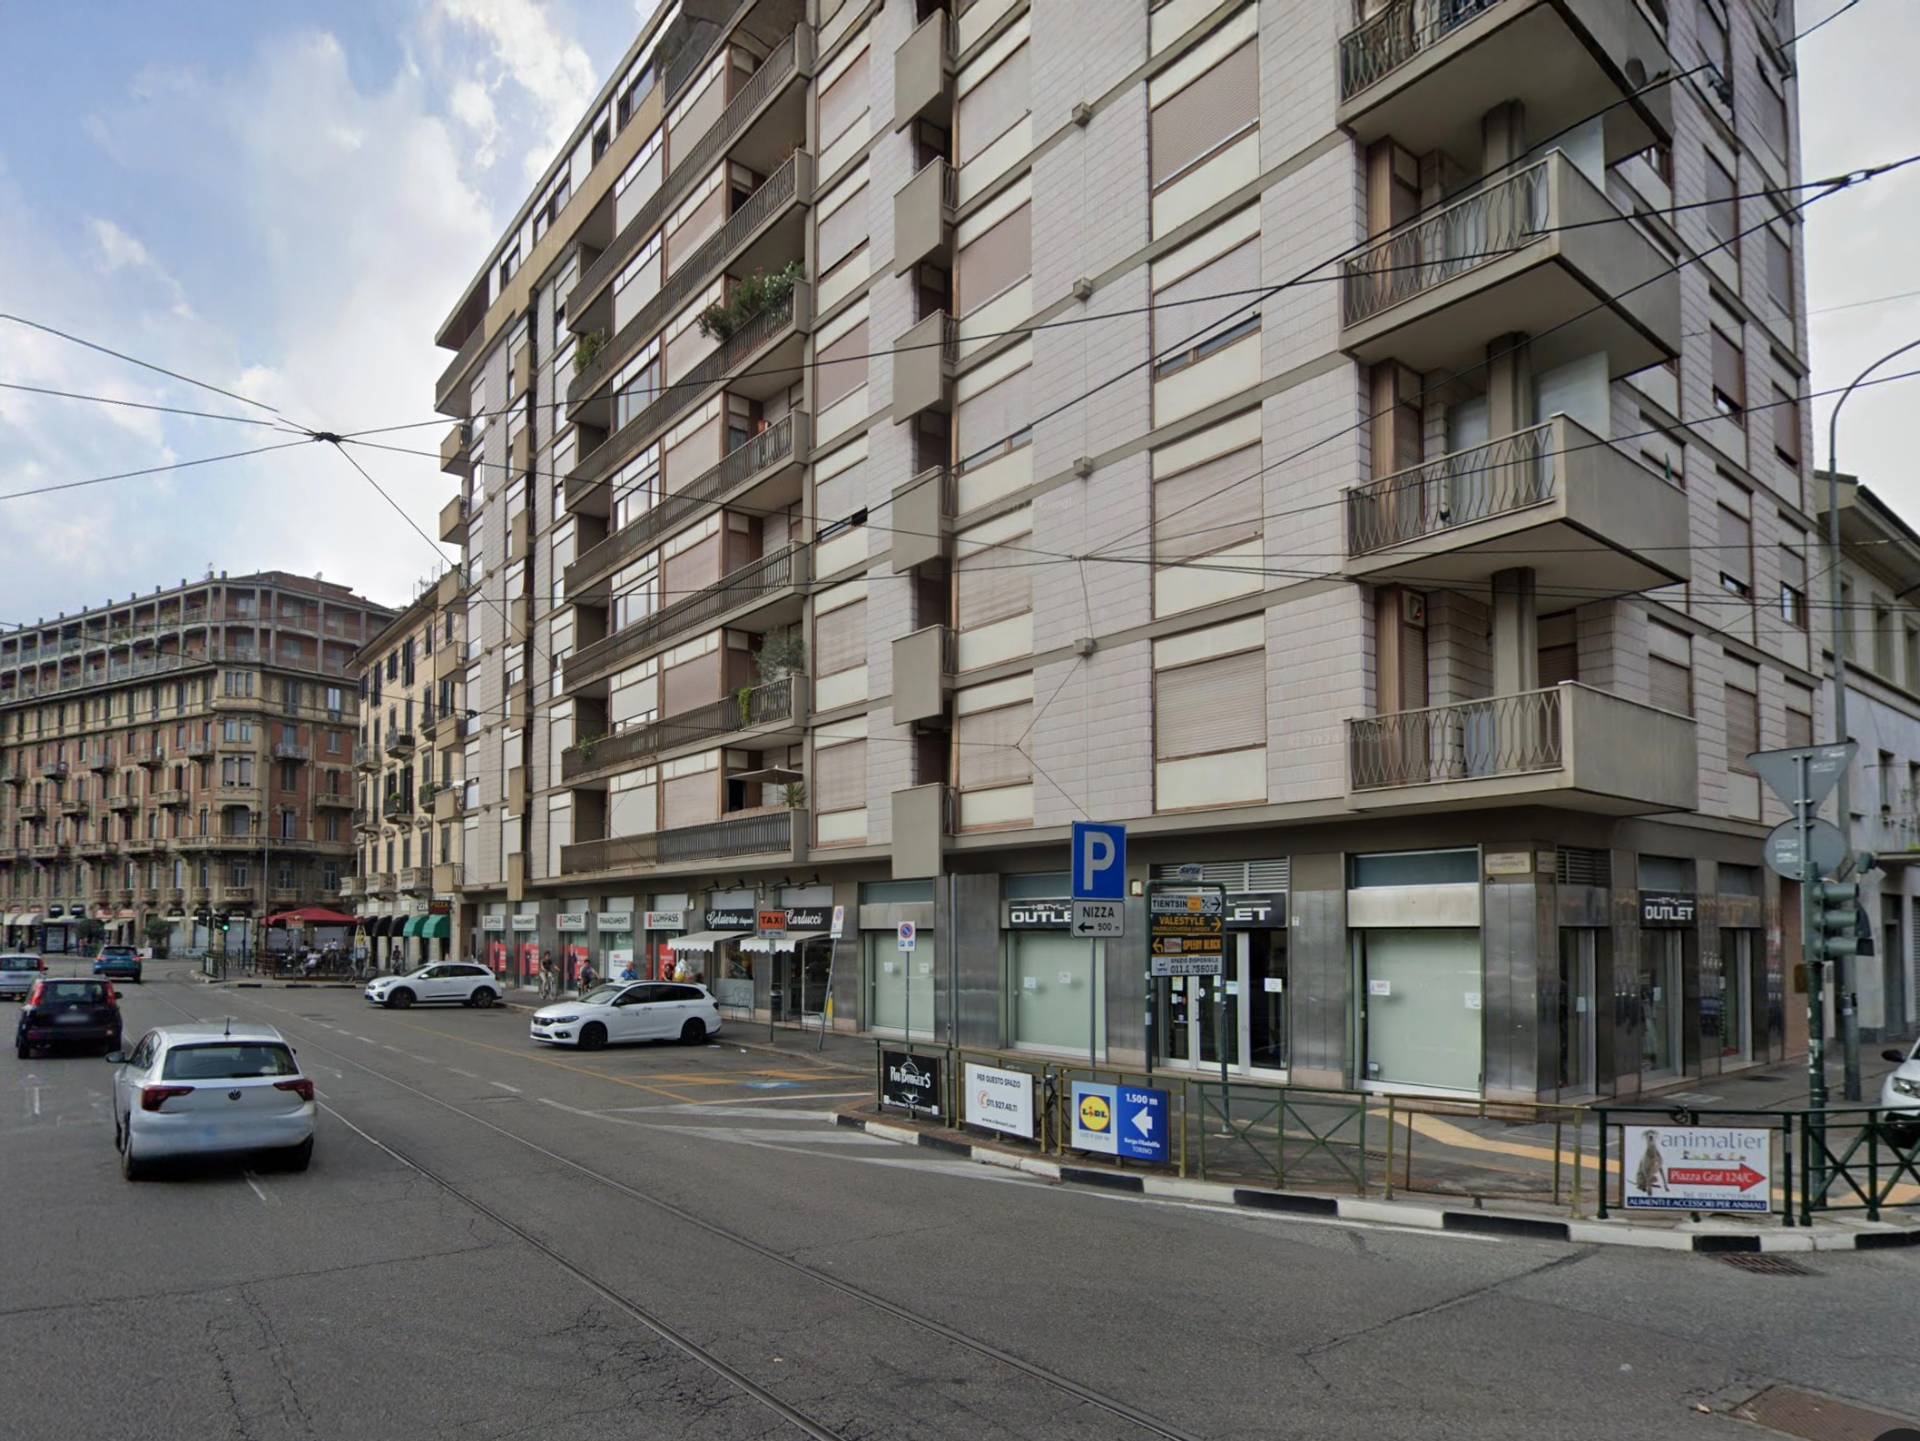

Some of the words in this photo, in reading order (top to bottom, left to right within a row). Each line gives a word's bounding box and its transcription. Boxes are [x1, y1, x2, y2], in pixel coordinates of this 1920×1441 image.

[1083, 831, 1116, 890] P
[1153, 899, 1188, 908] TIENTSIN
[654, 913, 680, 923] COMPASS
[785, 908, 823, 925] Carducci
[1011, 910, 1072, 923] OUTLE
[1082, 906, 1115, 918] NIZZA
[1644, 905, 1694, 920] OUTLET
[760, 915, 785, 925] TAXI
[1160, 916, 1206, 926] VALESTYLE
[976, 1072, 985, 1081] PER
[986, 1075, 1004, 1085] QUESTO
[1004, 1078, 1021, 1088] SPAZIO
[1125, 1093, 1148, 1105] 1.500
[1149, 1098, 1158, 1106] m
[1661, 1132, 1766, 1150] animalier
[1671, 1170, 1700, 1181] Piazza
[1629, 1199, 1665, 1207] ALIMENTI
[1673, 1200, 1715, 1208] ACCESSORI
[1717, 1201, 1731, 1209] PER
[1731, 1201, 1766, 1209] ANIMALI
